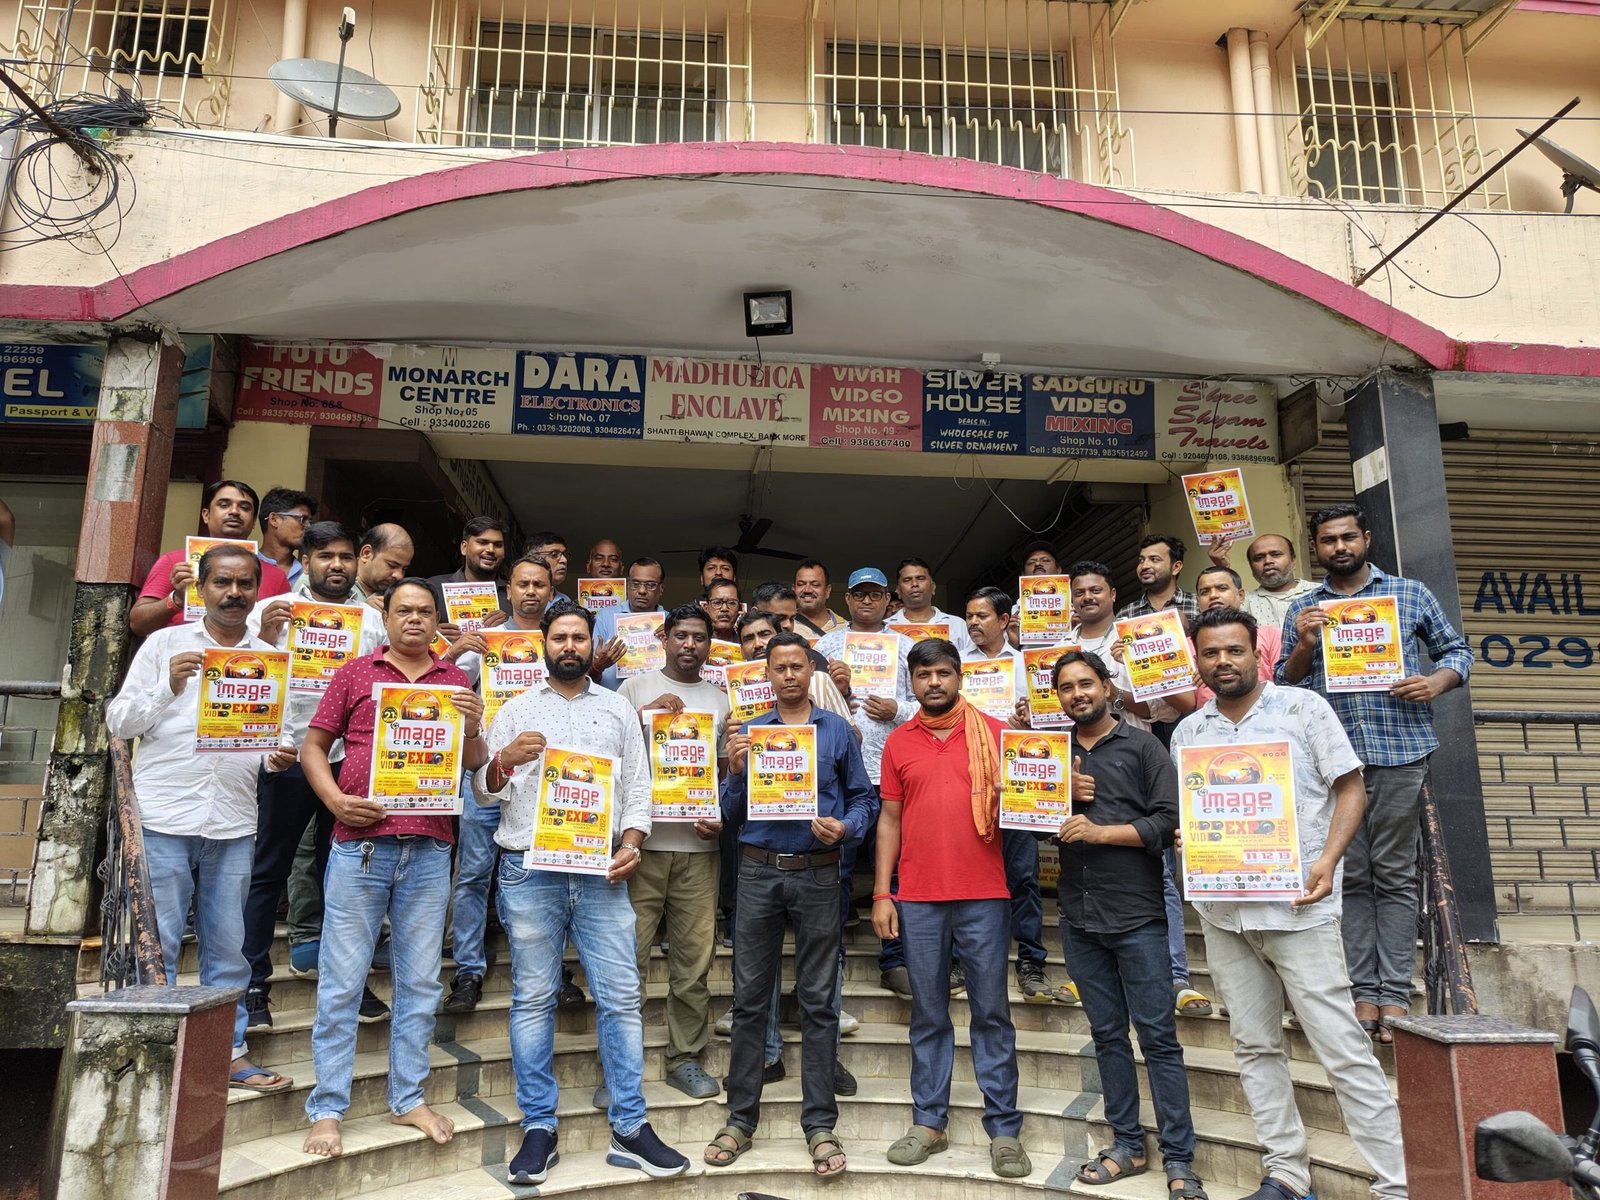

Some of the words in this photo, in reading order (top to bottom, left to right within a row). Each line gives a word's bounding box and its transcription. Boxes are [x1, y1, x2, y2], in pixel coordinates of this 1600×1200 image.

[4, 345, 45, 354] 22259
[272, 340, 347, 366] FOTO
[243, 367, 373, 396] FRIENDS
[388, 366, 509, 387] MONARCH
[523, 355, 641, 393] DARA
[651, 357, 805, 389] MADHULICA
[832, 366, 901, 384] VIVAH
[926, 370, 1023, 392] SILVER
[0, 368, 64, 398] EL
[1032, 374, 1146, 395] SADGURU
[400, 386, 496, 405] CENTRE
[830, 387, 903, 403] VIDEO
[1177, 382, 1258, 404] Shree
[236, 407, 254, 416] Cell
[270, 397, 298, 408] Shop
[415, 405, 443, 417] Shop
[465, 407, 478, 416] 05
[520, 394, 641, 413] ELECTRONICS
[671, 393, 784, 422] ENCLAVE
[926, 395, 1022, 414] HOUSE
[1050, 396, 1127, 414] VIDEO
[9, 406, 67, 418] Passport
[72, 407, 81, 416] &
[549, 412, 576, 423] Shop
[579, 413, 596, 423] No.
[599, 413, 611, 423] 07
[822, 407, 910, 424] MIXING
[1168, 404, 1267, 430] Shyam
[400, 416, 420, 427] Cell
[429, 418, 490, 429] 9334003266
[835, 425, 861, 435] Shop
[864, 425, 881, 435] No.
[1045, 415, 1133, 435] MIXING
[782, 433, 806, 442] MORE
[821, 437, 841, 446] Cell
[851, 438, 911, 448] 9386367400
[940, 428, 994, 440] WHOLESALE
[997, 430, 1009, 440] OF
[1060, 435, 1085, 447] Shop
[1087, 436, 1104, 446] No.
[1107, 437, 1118, 446] 10
[1168, 426, 1270, 450] Travels
[930, 440, 963, 450] SILVER
[966, 441, 1018, 452] ORNAMENT
[1029, 445, 1045, 454] Cell
[1197, 494, 1234, 508] image
[1029, 597, 1061, 608] image
[1473, 571, 1600, 616] AVAIL
[301, 630, 347, 648] image
[1337, 627, 1384, 643] image
[1133, 637, 1173, 653] image
[1466, 634, 1600, 668] 029
[496, 669, 542, 686] image
[700, 669, 723, 679] ima
[216, 683, 271, 701] image
[741, 687, 773, 699] imag
[393, 727, 446, 748] image
[665, 744, 705, 764] image
[761, 755, 803, 771] image
[1013, 763, 1057, 779] image
[554, 785, 599, 808] image
[1201, 792, 1273, 816] image
[1278, 819, 1290, 843] 2025
